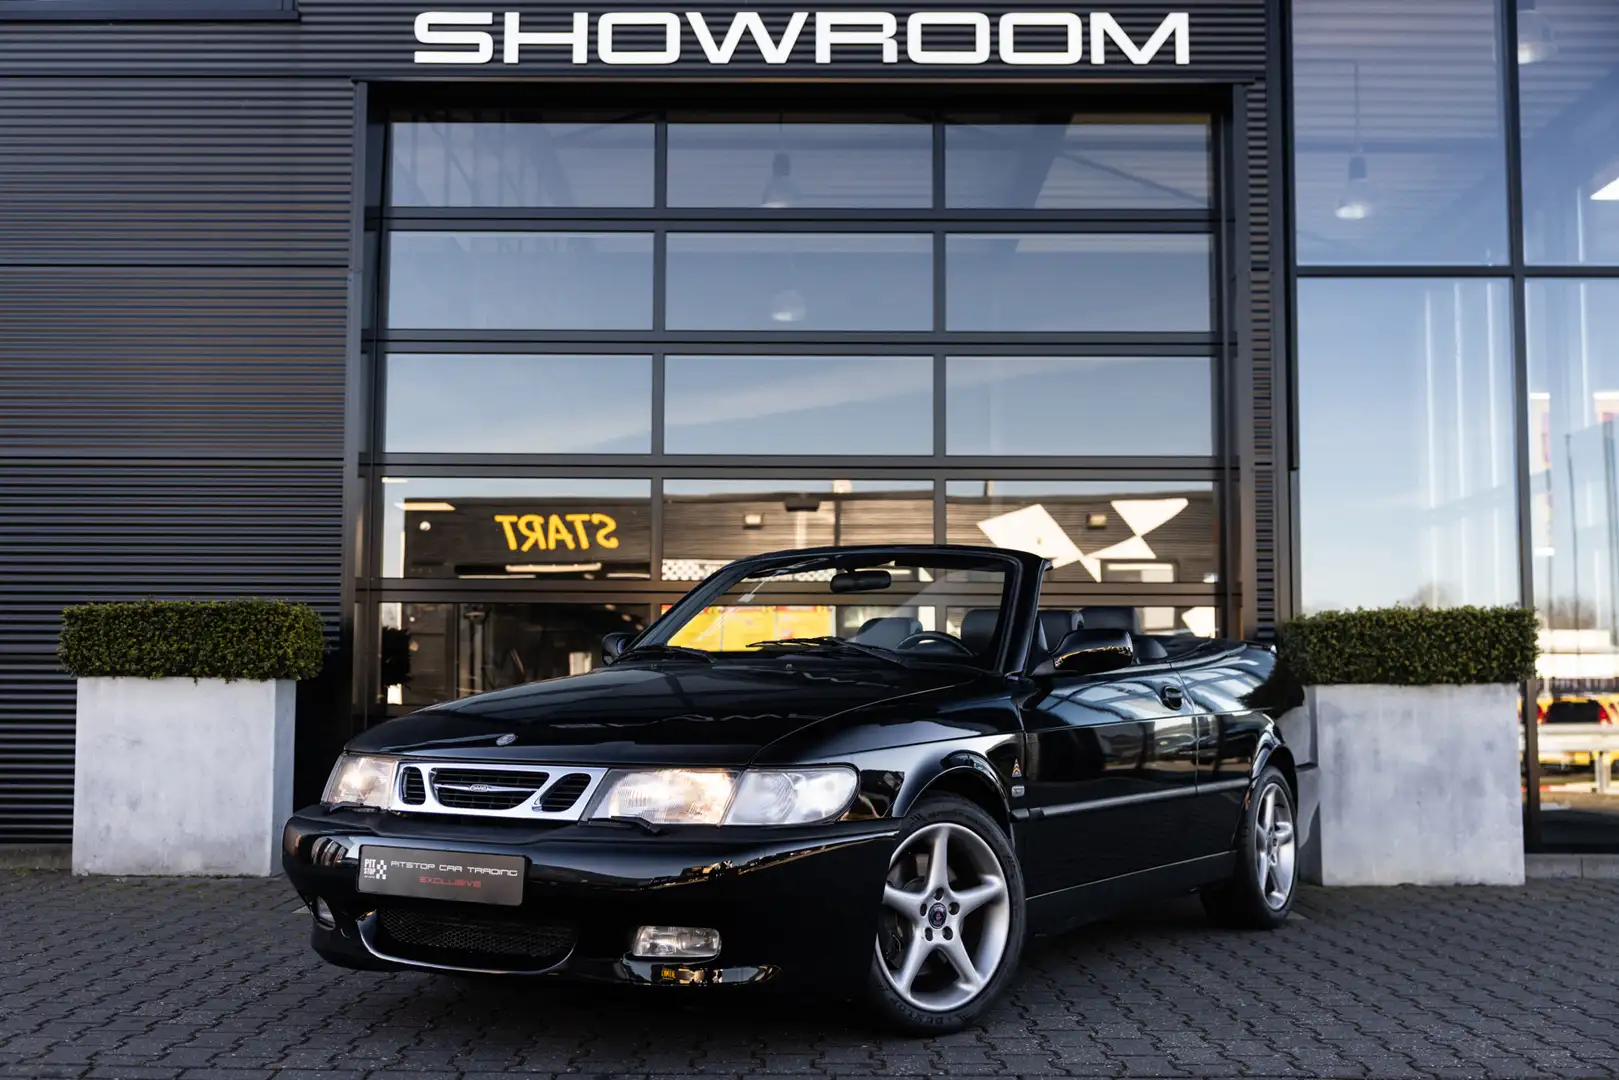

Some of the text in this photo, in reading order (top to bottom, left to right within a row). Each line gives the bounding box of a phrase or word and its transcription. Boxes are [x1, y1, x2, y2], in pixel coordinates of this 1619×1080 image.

[413, 11, 1190, 65] SHOWROOM
[364, 858, 376, 868] PIT
[390, 860, 518, 877] PITSTOP CAR TRADING
[419, 876, 482, 888] EXCLUSIVE
